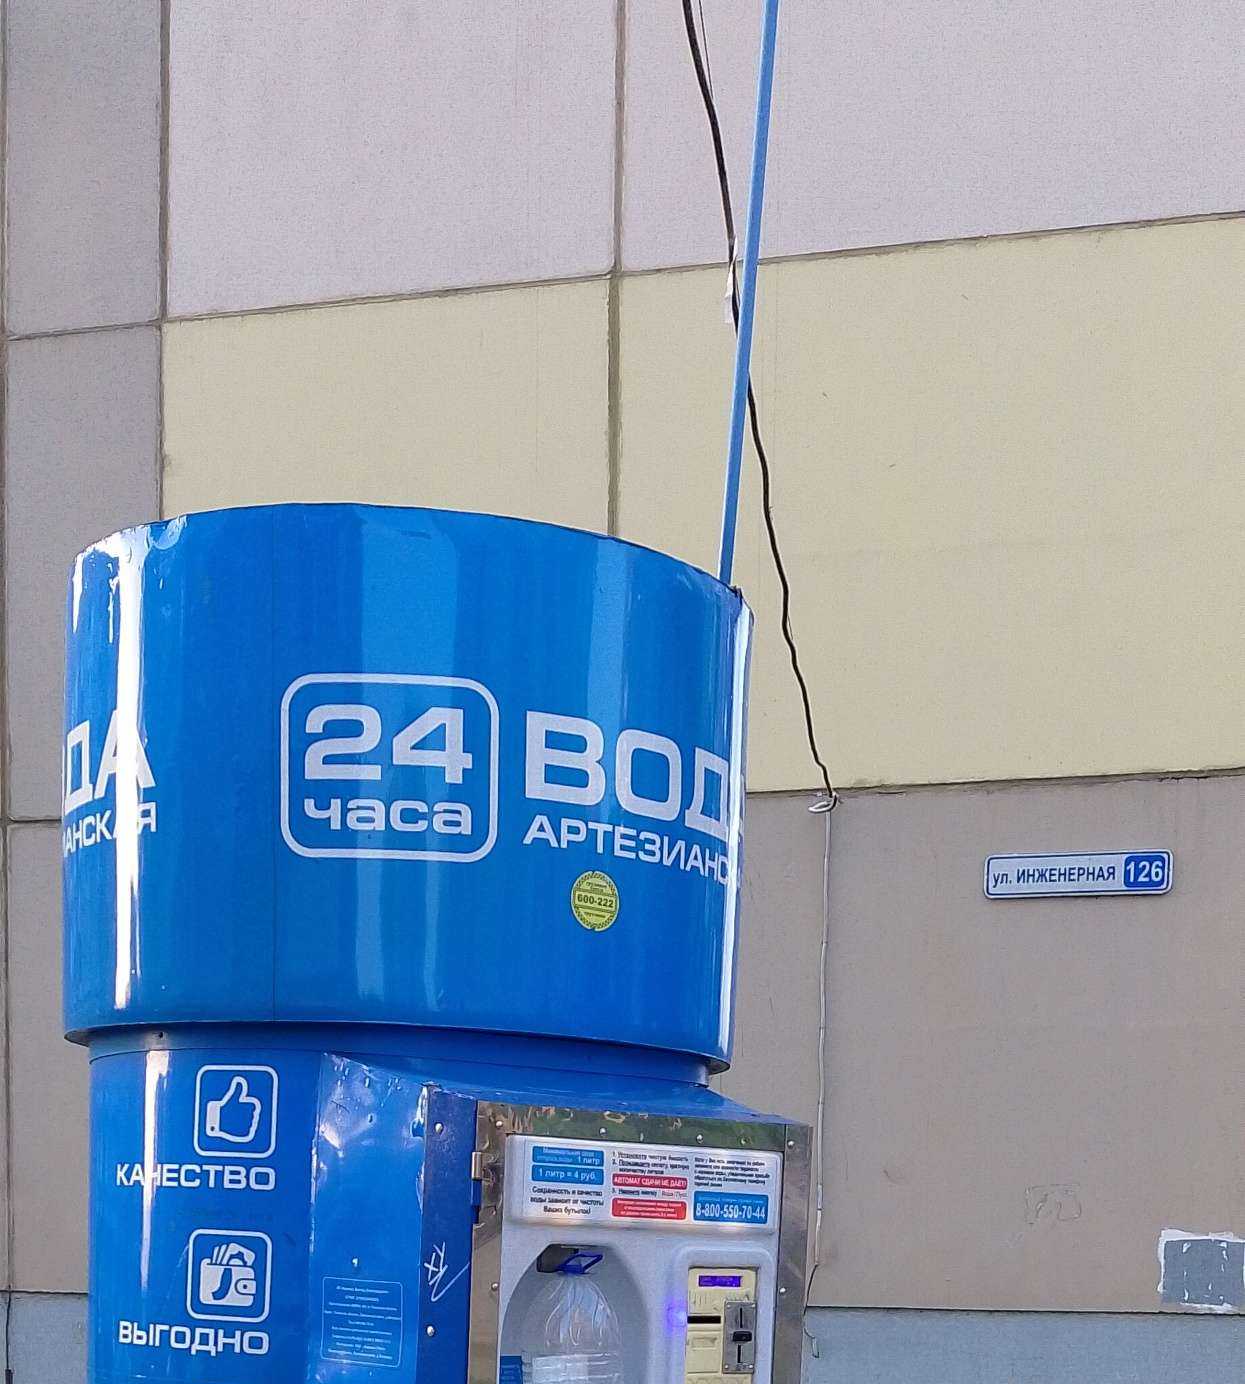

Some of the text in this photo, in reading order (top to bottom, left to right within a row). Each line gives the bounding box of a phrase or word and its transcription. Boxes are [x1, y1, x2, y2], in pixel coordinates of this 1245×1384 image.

[304, 703, 473, 785] 24
[525, 710, 743, 843] ВОД
[303, 797, 472, 836] часа
[992, 860, 1164, 889] ул. ИНЖЕНЕРНАЯ 126
[577, 893, 614, 908] 600-222
[545, 1170, 565, 1179] литр
[695, 1203, 766, 1220] 8-800-550-70-44
[118, 1320, 269, 1356] ВЫГОДНО
